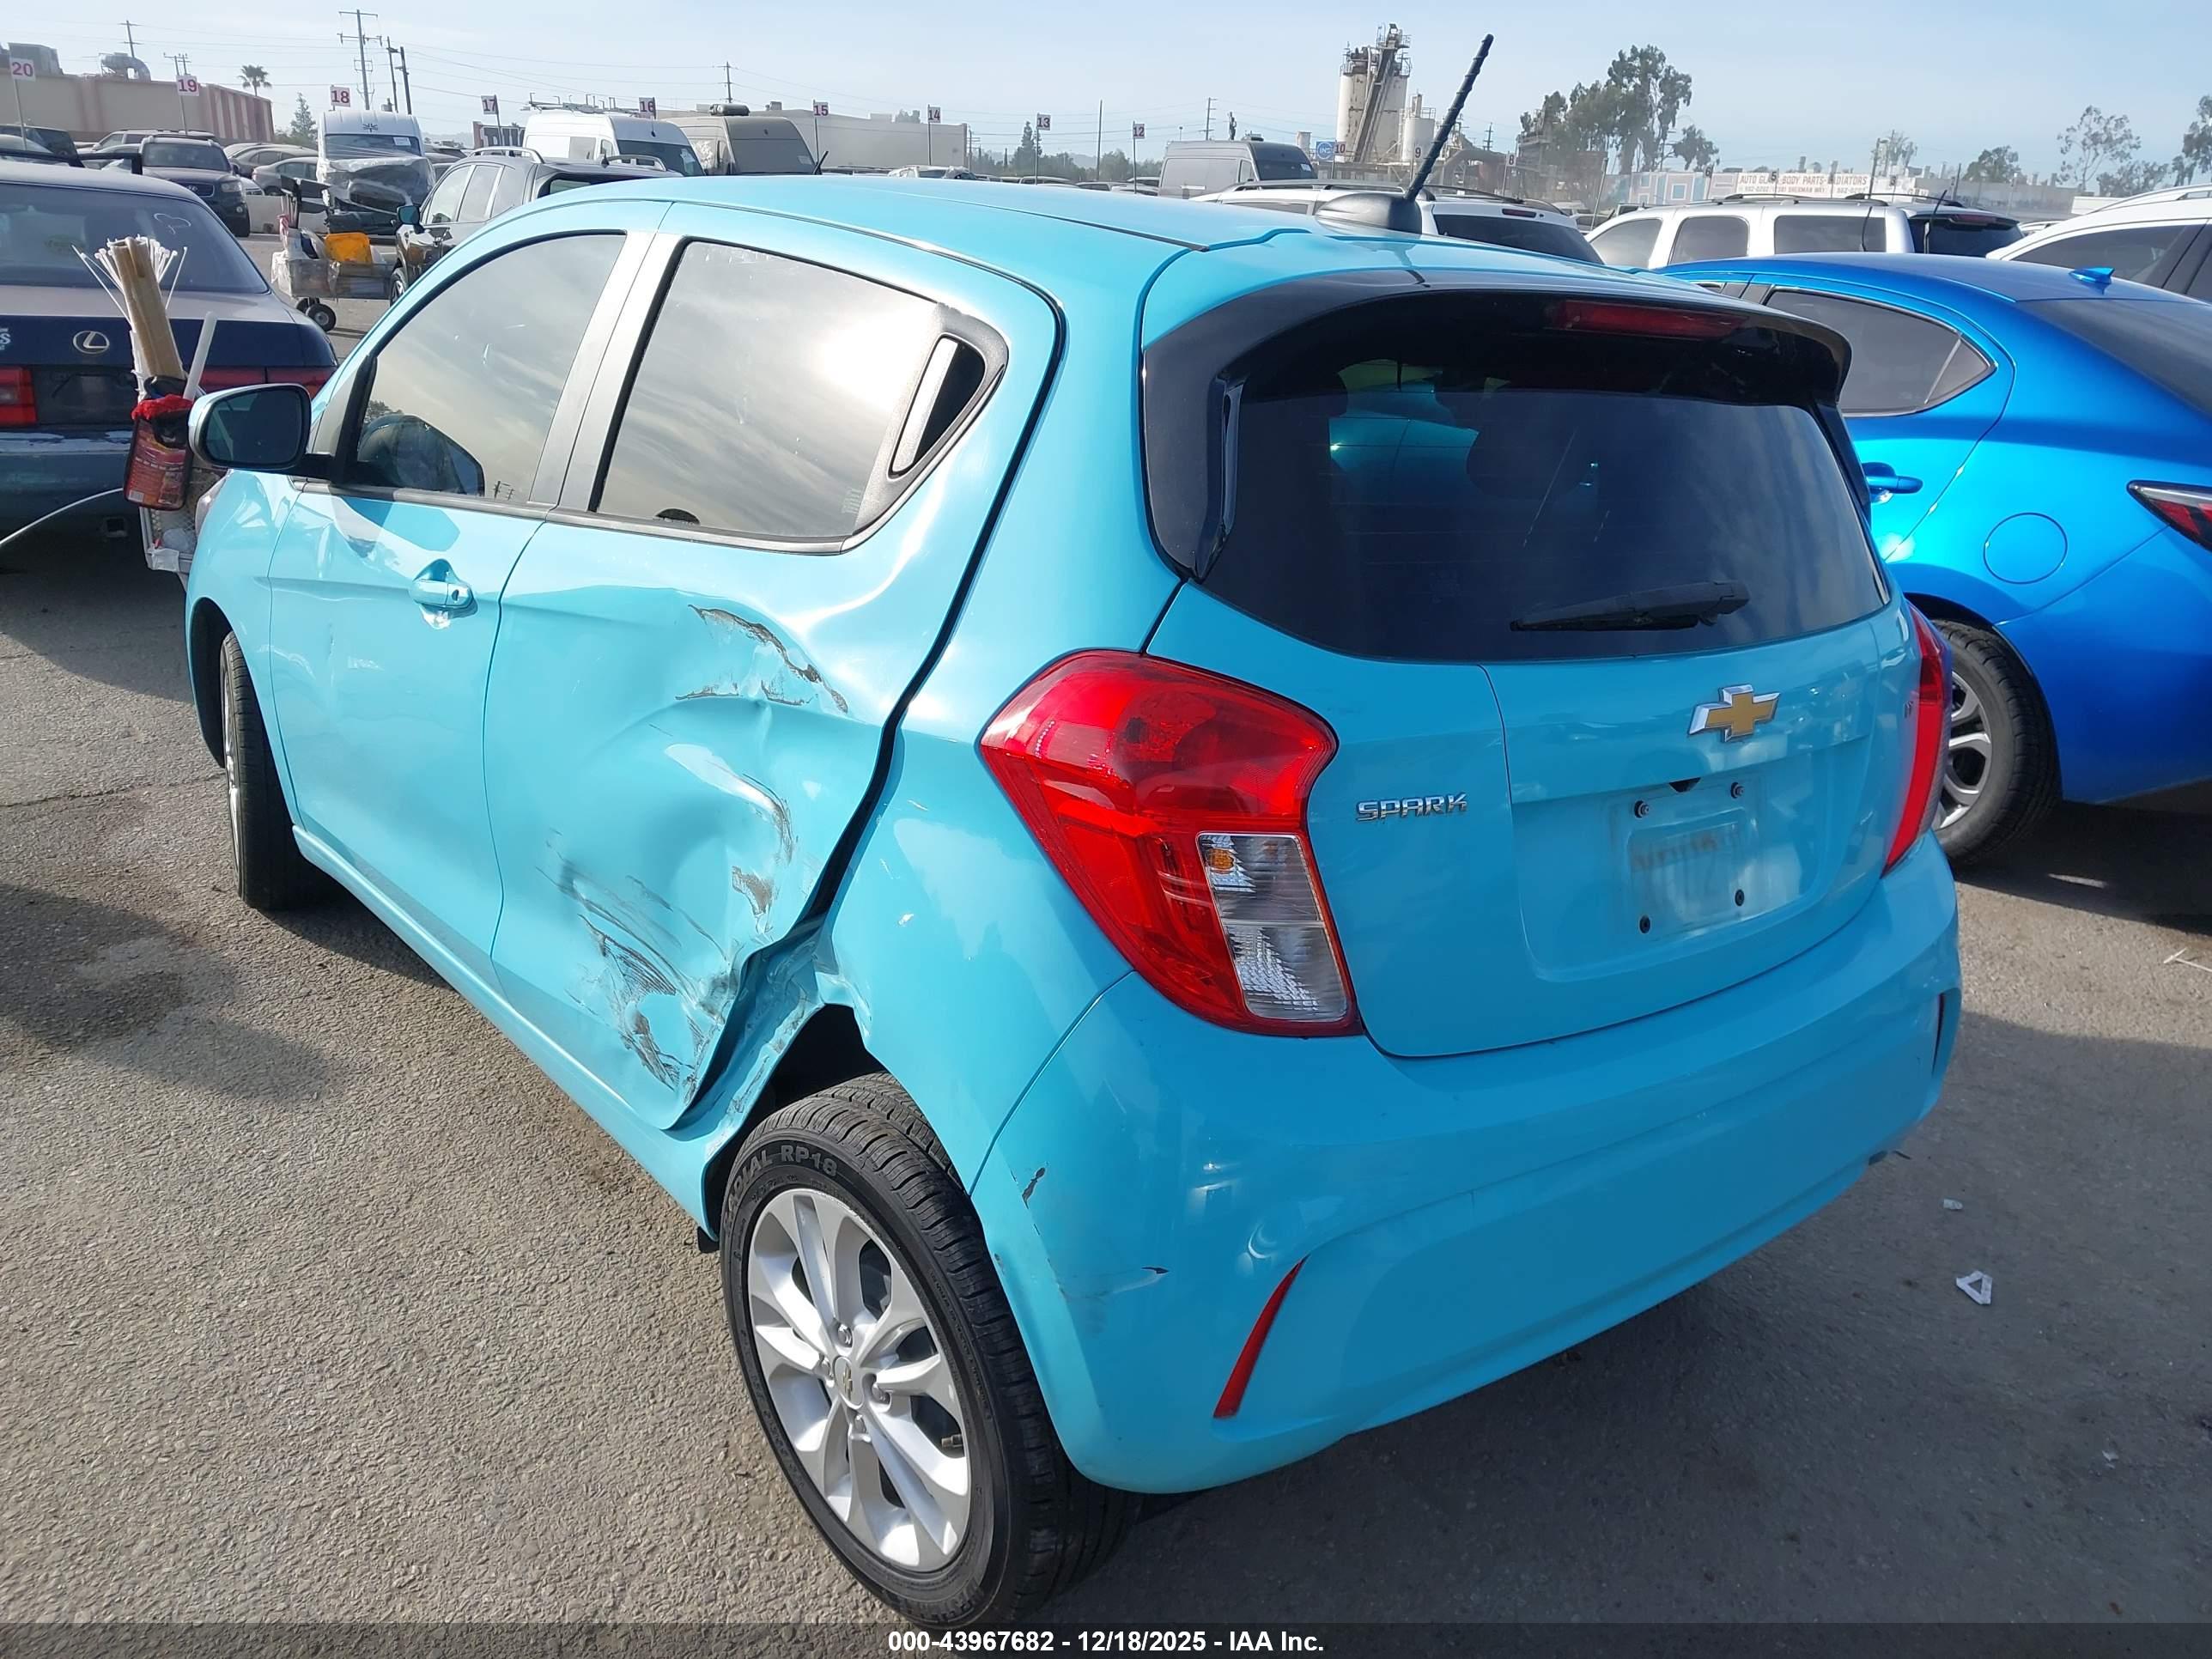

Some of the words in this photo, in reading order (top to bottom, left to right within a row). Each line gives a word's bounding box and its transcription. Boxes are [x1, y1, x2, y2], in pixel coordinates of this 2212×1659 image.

[12, 61, 33, 76] 20
[178, 78, 198, 92] 19
[331, 89, 349, 104] 18
[482, 98, 497, 112] 17
[813, 105, 829, 116] 15
[927, 109, 940, 120] 14
[1036, 117, 1050, 128] 13
[1133, 126, 1145, 137] 12
[1334, 143, 1346, 154] 10
[1414, 147, 1421, 158] 9
[1509, 155, 1515, 165] 8
[1739, 174, 1757, 185] AUTO
[1771, 171, 1778, 181] 5
[1356, 792, 1468, 822] SPARK
[780, 1145, 838, 1177] RP18
